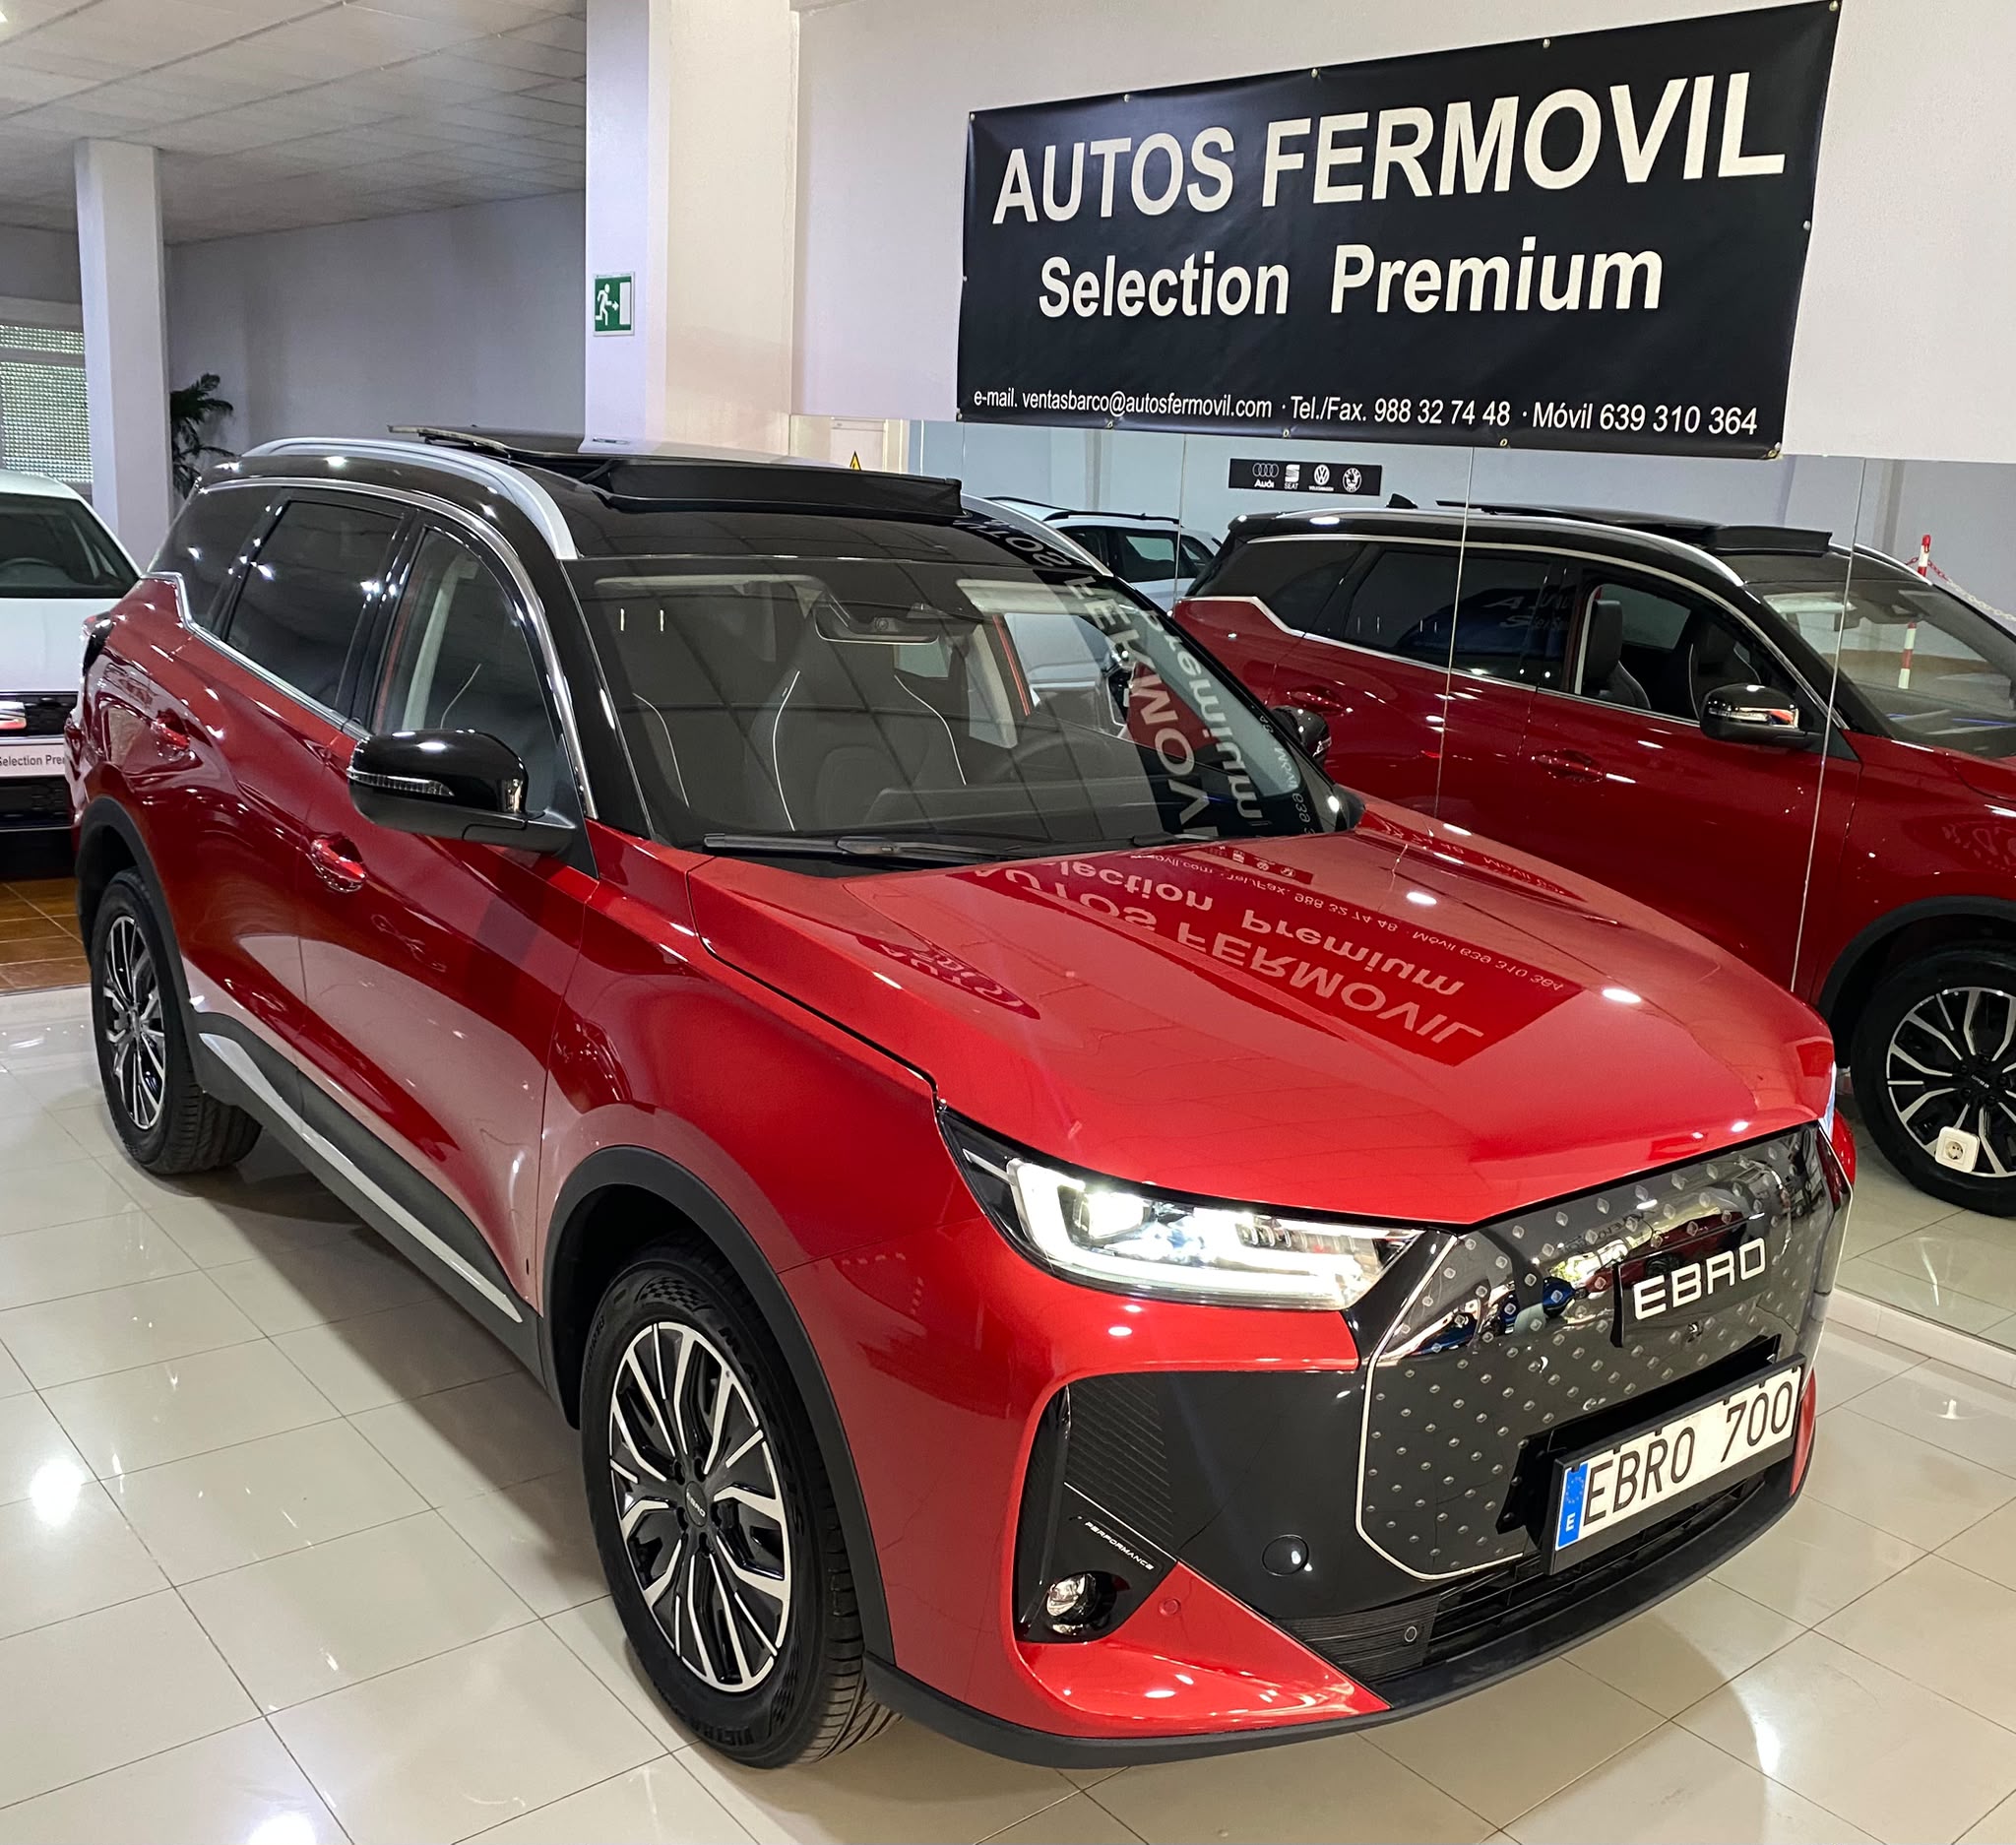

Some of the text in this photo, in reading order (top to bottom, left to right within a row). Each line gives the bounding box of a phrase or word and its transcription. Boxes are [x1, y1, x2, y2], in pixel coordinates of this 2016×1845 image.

[992, 72, 1786, 224] AUTOS FERMOVIL
[1039, 235, 1663, 318] Selection Premium
[974, 387, 1018, 408] e-mail.
[1022, 390, 1272, 423] ventasbarco@autosfermovil.com
[1374, 398, 1412, 423] 988
[1417, 399, 1444, 424] 32
[1451, 400, 1476, 425] 74
[1481, 400, 1511, 427] 48
[1532, 401, 1594, 429] Móvil
[1600, 403, 1646, 431] 639
[1652, 405, 1701, 433] 310
[1708, 406, 1758, 435] 364
[1253, 478, 1275, 488] Audi
[1632, 1237, 1766, 1321] EBRO
[1583, 1380, 1794, 1527] EBRO 700
[1084, 1521, 1155, 1570] PERFORMANCE
[1565, 1513, 1576, 1532] E
